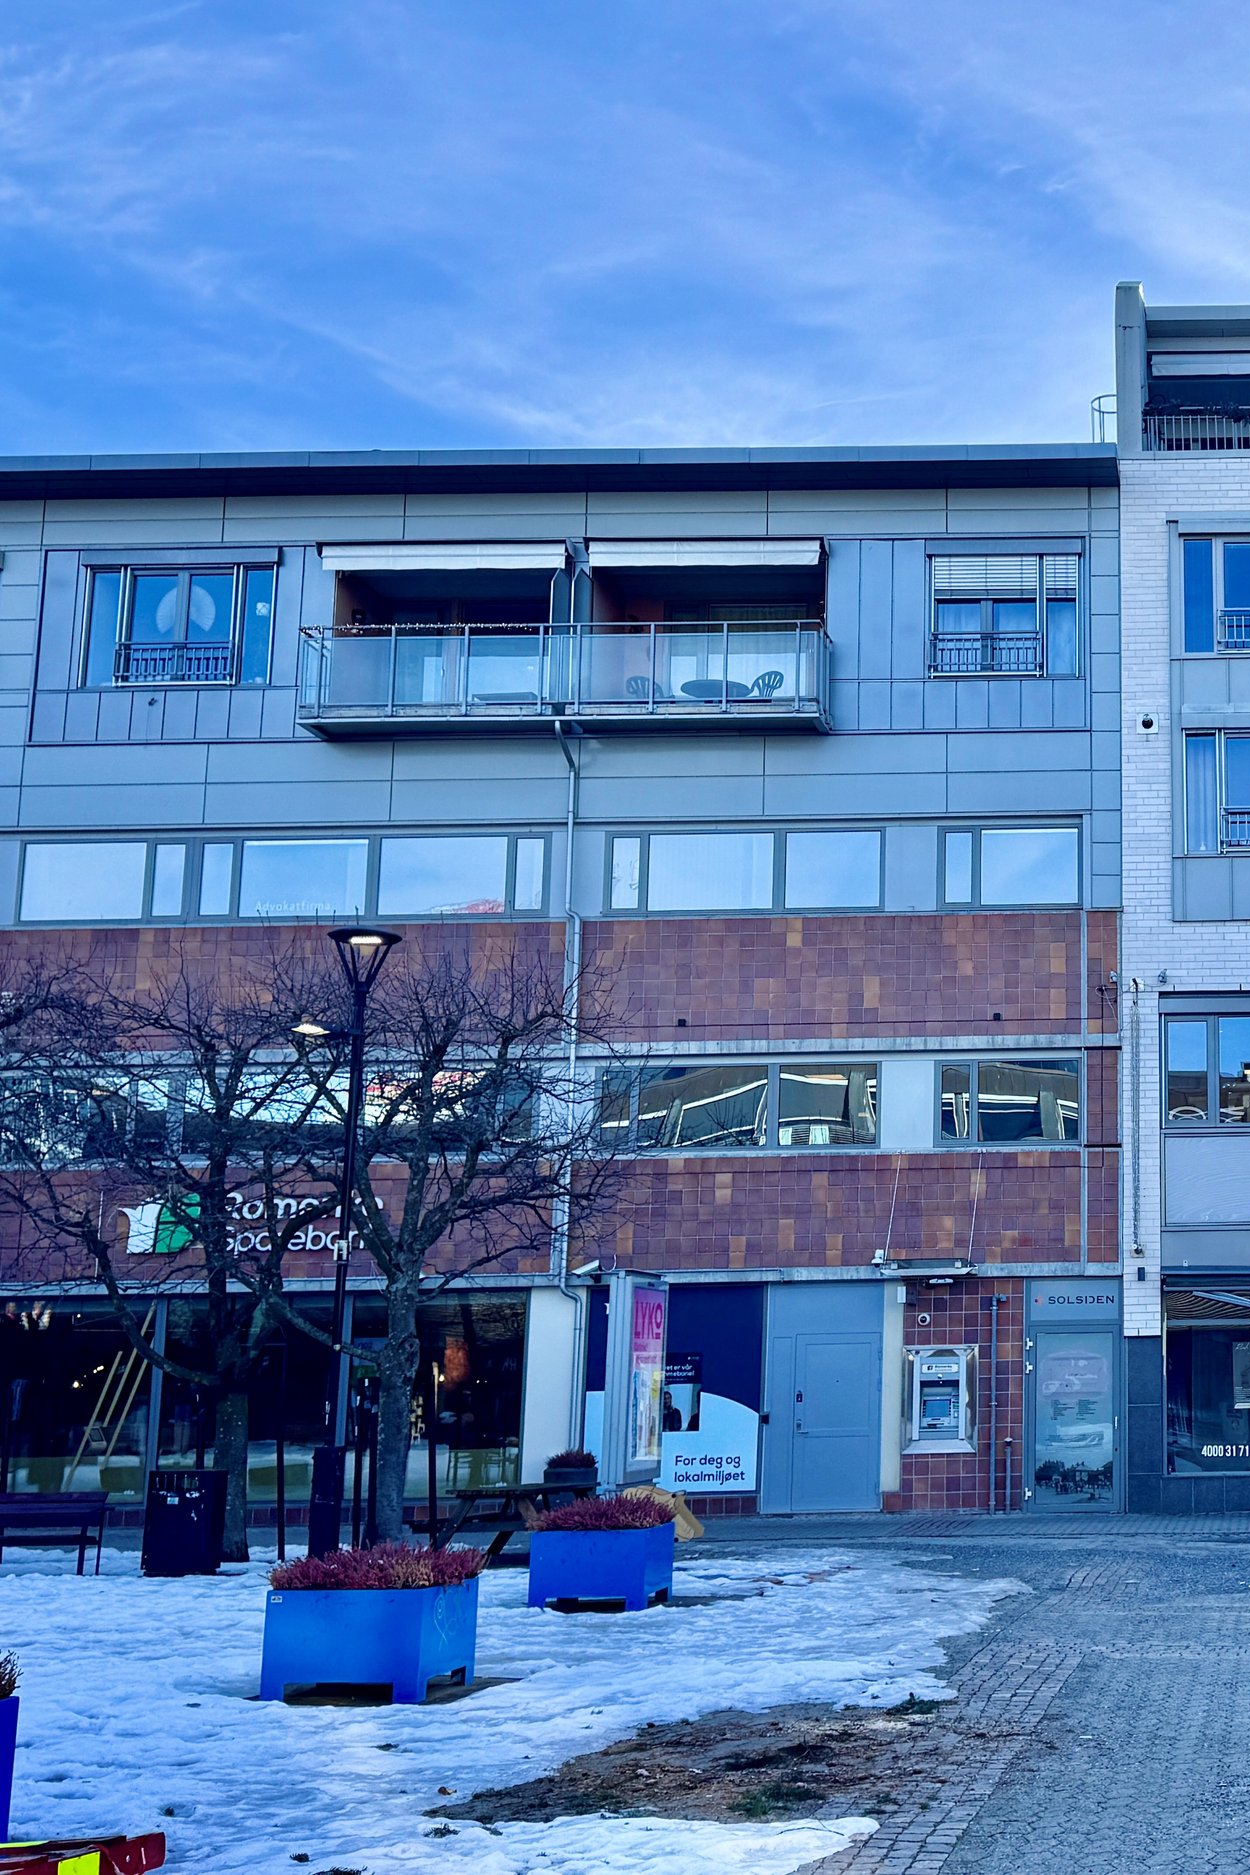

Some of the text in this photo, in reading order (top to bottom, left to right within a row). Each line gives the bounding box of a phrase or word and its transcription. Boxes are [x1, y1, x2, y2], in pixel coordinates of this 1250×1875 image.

[1048, 1295, 1115, 1305] SOLSIDEN
[1201, 1445, 1224, 1457] 4000
[675, 1454, 741, 1469] For deg og
[674, 1470, 745, 1485] lokalmiljøet
